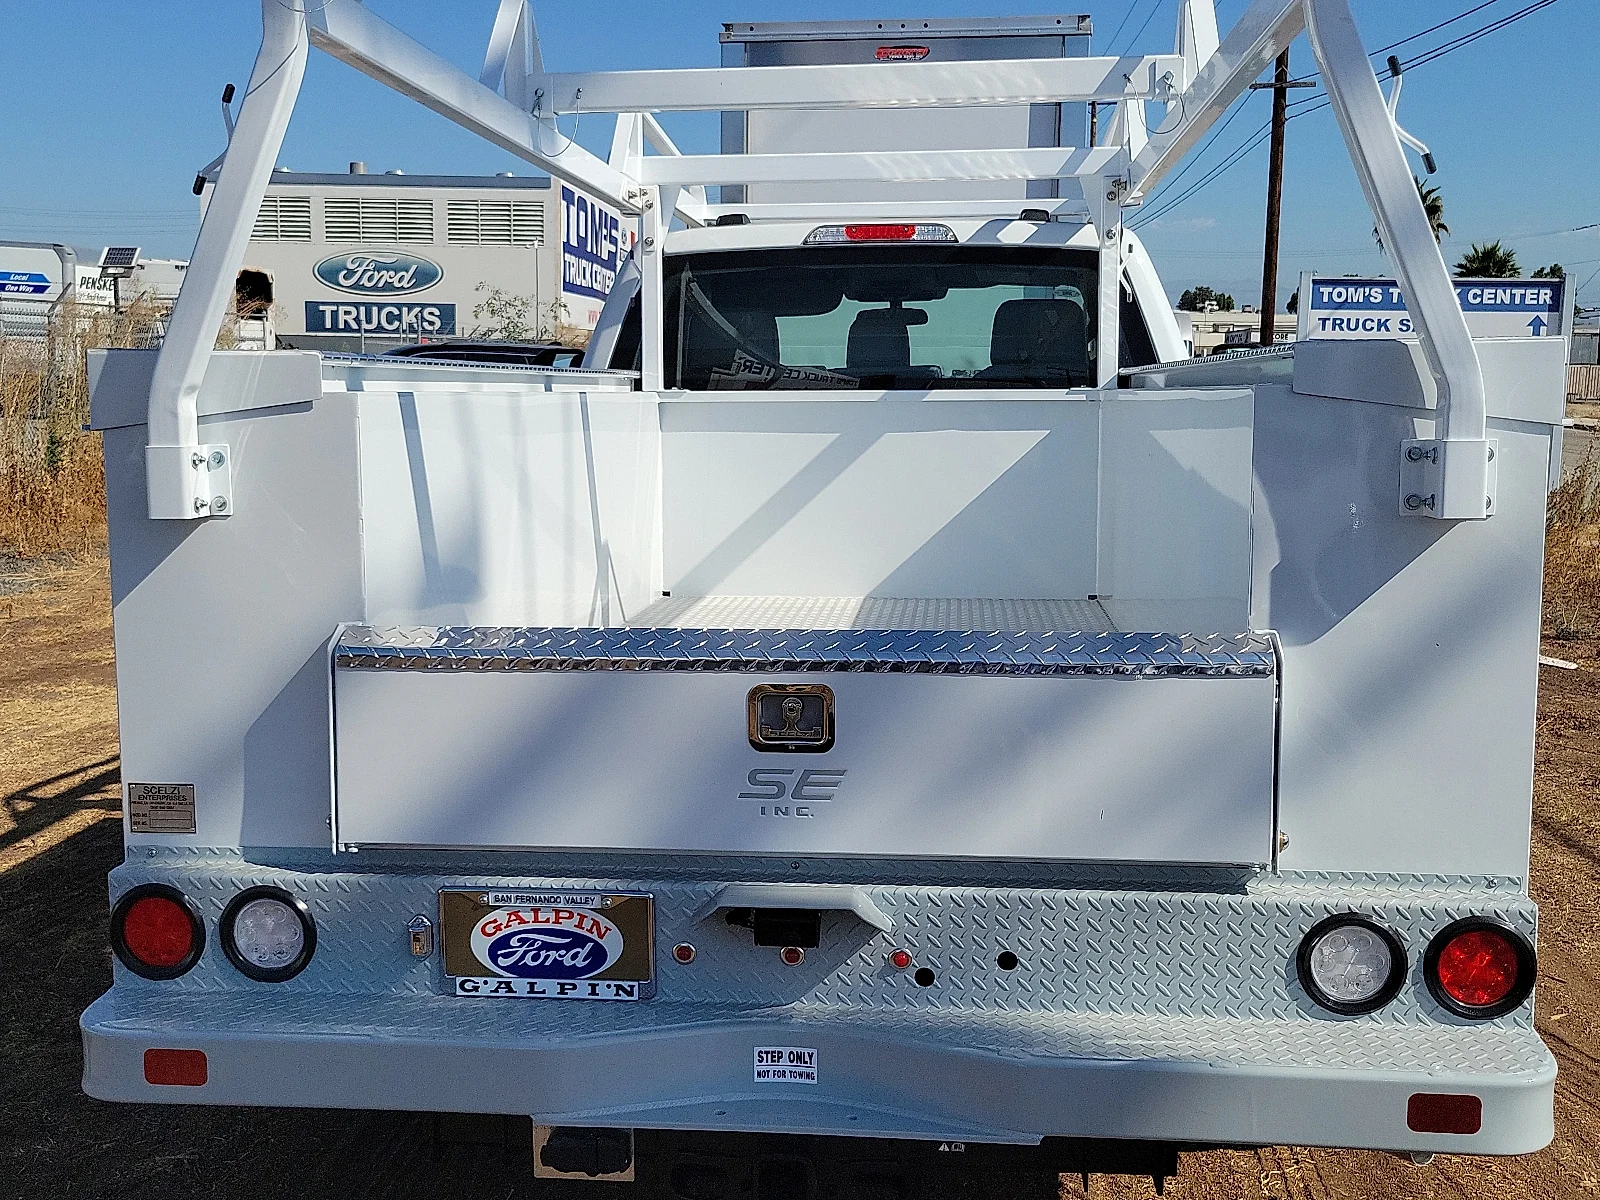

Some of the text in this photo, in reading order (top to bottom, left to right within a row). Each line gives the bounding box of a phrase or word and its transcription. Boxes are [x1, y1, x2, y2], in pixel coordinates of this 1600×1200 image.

[562, 185, 619, 262] TOM'S
[338, 255, 418, 289] Ford
[565, 253, 615, 294] TRUCK CENTER
[5, 284, 34, 293] One Way
[80, 276, 114, 292] PENSKE
[1319, 287, 1382, 304] TOM'S
[1467, 288, 1552, 305] CENTER
[319, 305, 442, 331] TRUCKS
[1318, 317, 1391, 332] TRUCK
[143, 786, 180, 795] SCELZI
[738, 768, 847, 800] SE
[760, 806, 814, 817] INC.
[494, 894, 595, 905] SAN FERNANDO VALLEY
[480, 907, 612, 940] GALPIN
[497, 933, 594, 967] Ford
[757, 1050, 814, 1065] STEP ONLY
[756, 1070, 815, 1080] NOT FOR TOWING
